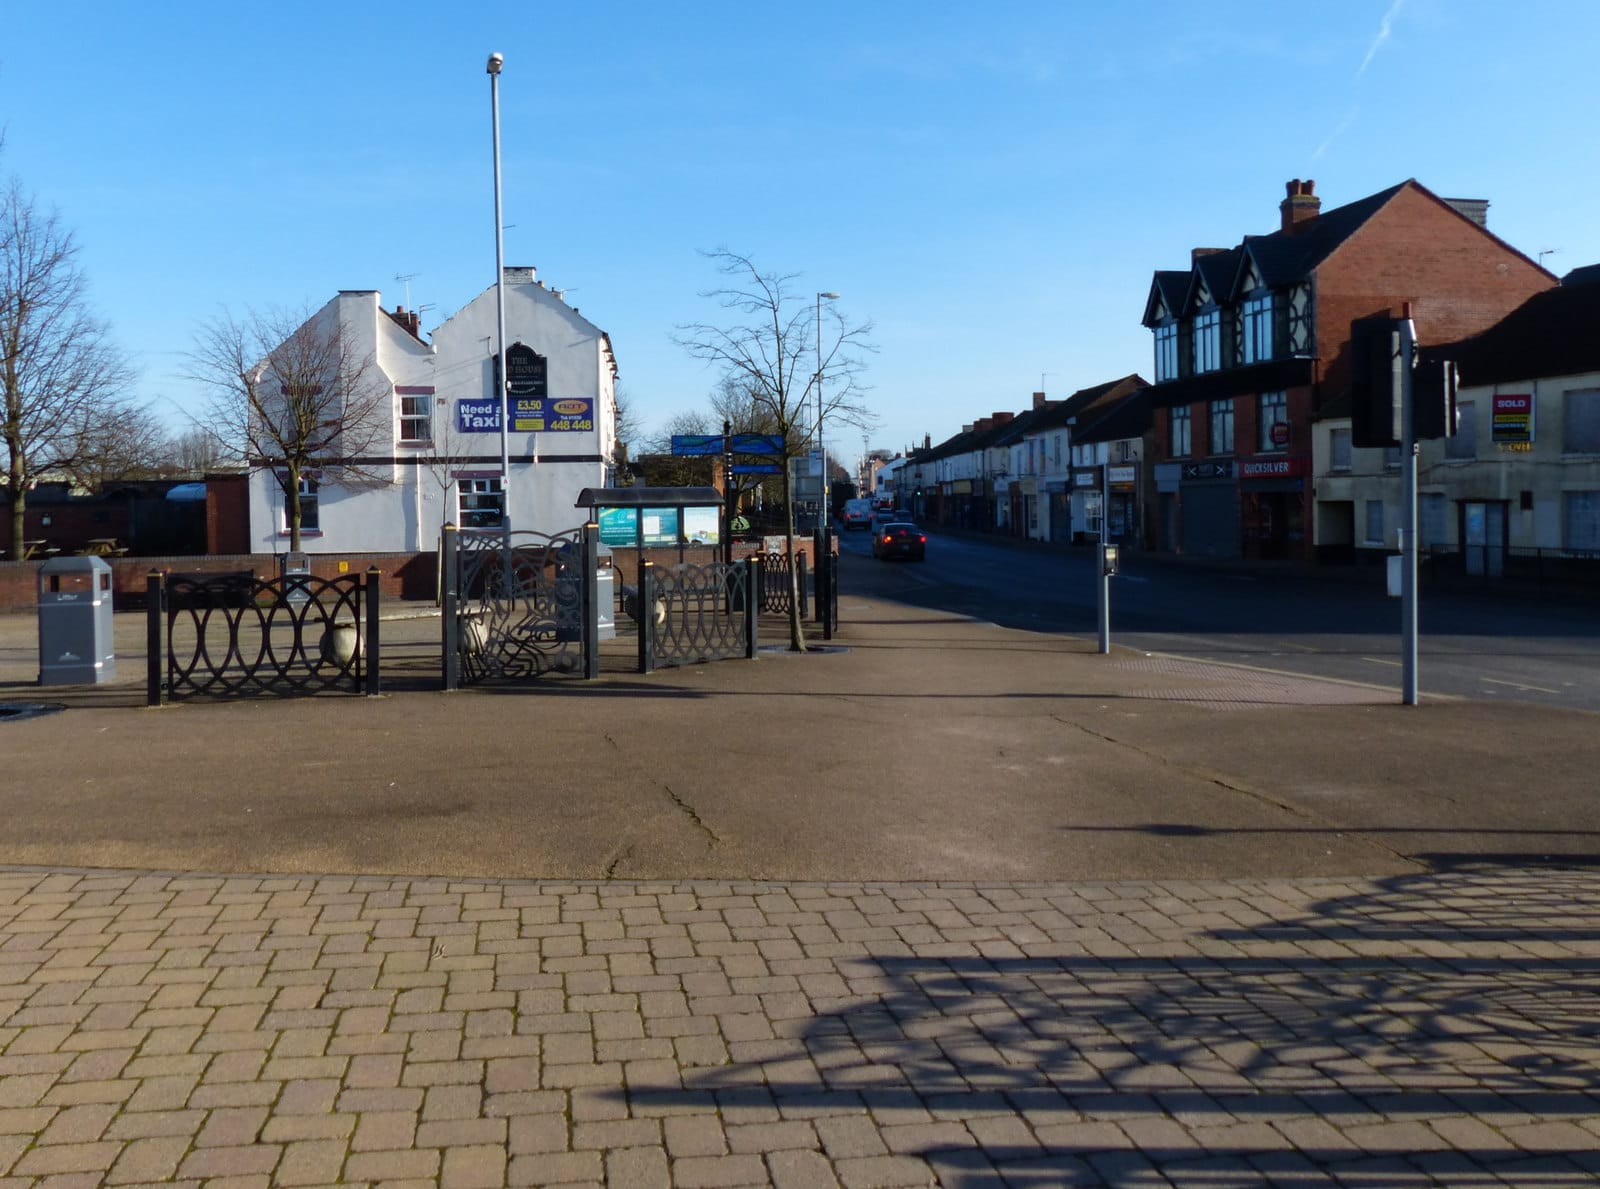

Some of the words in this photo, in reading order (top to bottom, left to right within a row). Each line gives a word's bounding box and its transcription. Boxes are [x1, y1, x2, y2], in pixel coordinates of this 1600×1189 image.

[460, 404, 493, 414] Need
[517, 399, 542, 410] £3.50
[1498, 400, 1526, 408] SOLD
[550, 420, 570, 430] 448
[572, 420, 592, 430] 448
[1244, 462, 1289, 474] QUICKSILVER
